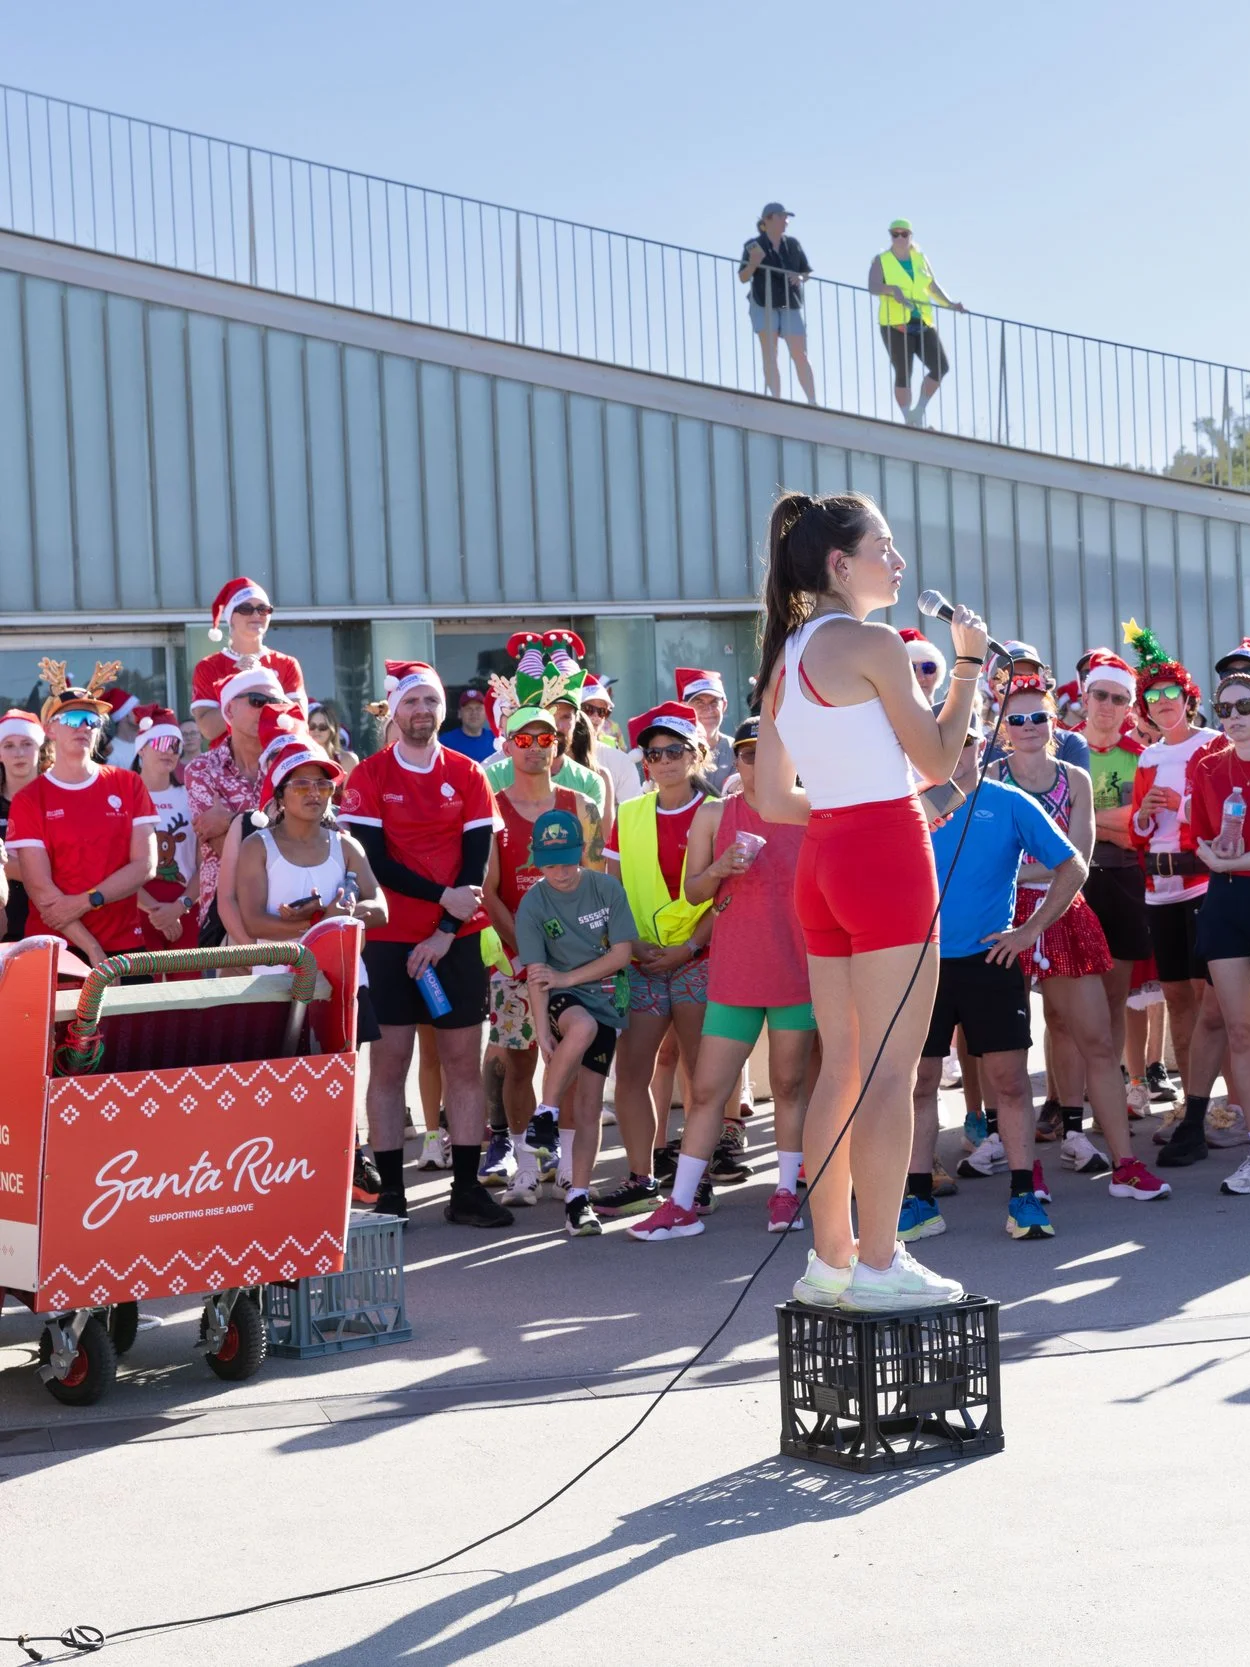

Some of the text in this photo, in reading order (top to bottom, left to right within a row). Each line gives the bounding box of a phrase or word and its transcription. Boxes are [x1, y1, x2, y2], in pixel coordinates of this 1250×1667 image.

[0, 1170, 25, 1195] NCE
[82, 1136, 316, 1230] Santa Run
[149, 1203, 254, 1223] SUPPORTING RISE ABOVE
